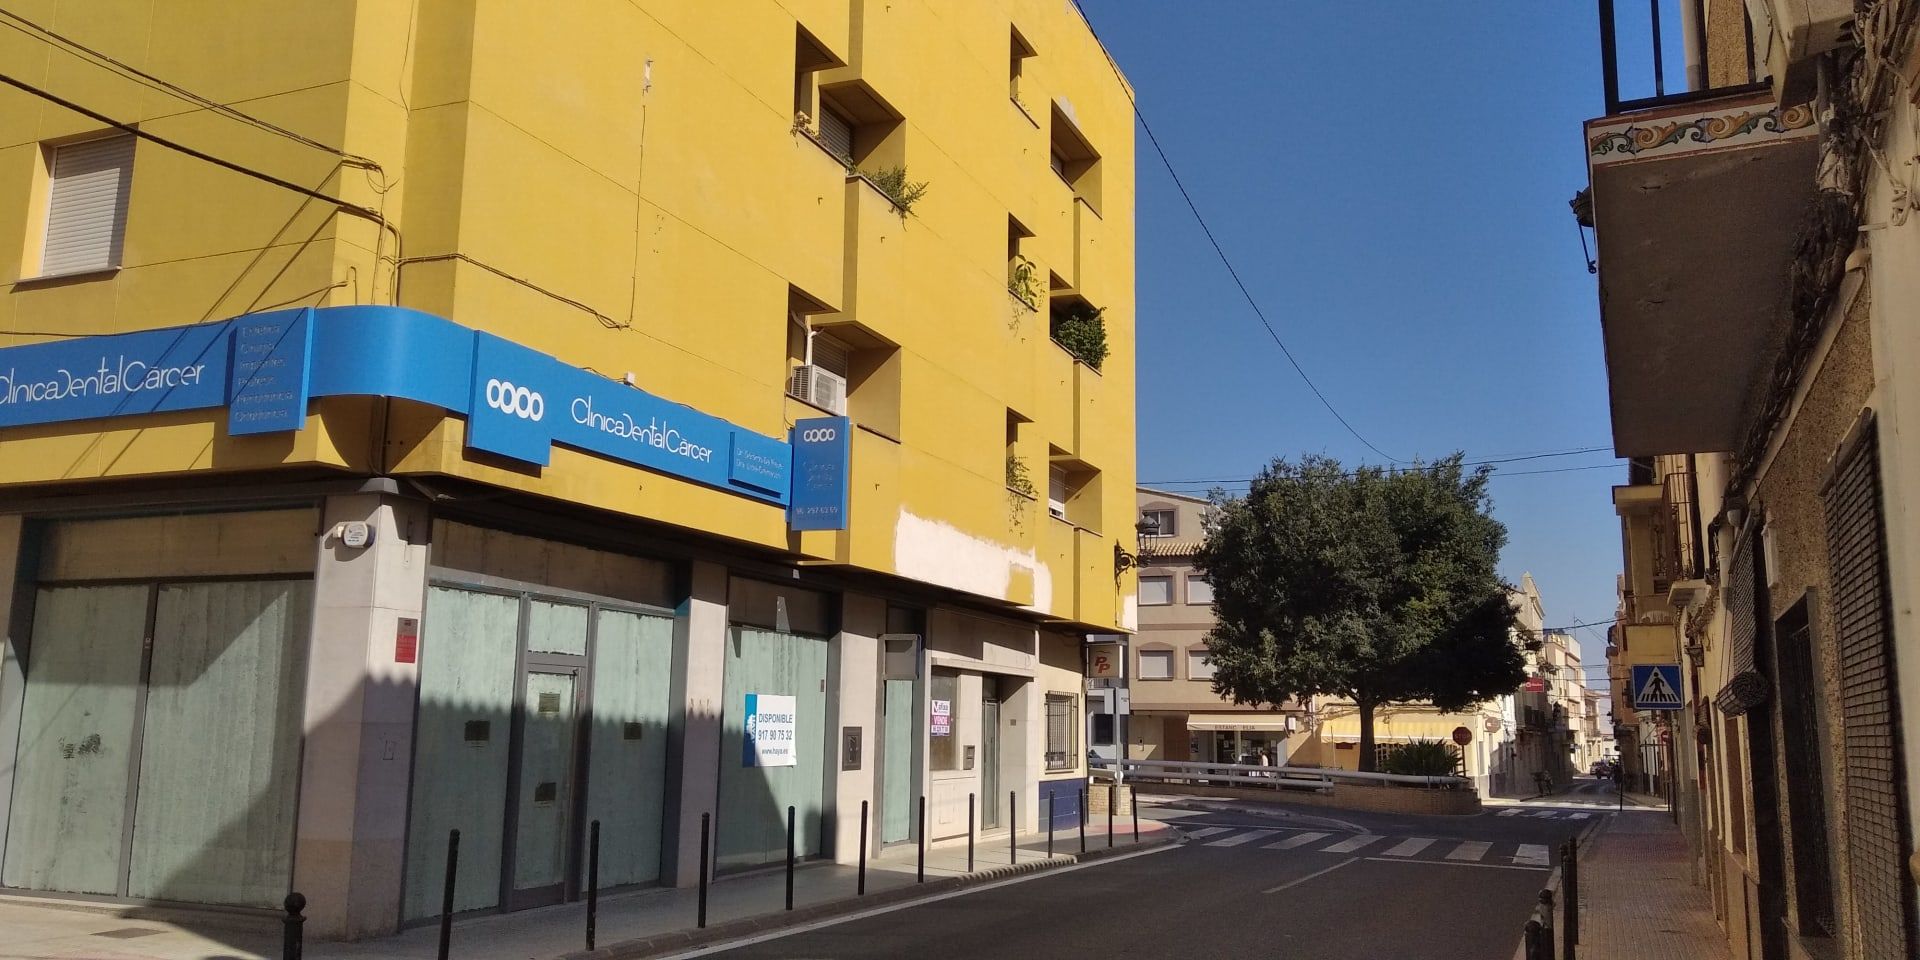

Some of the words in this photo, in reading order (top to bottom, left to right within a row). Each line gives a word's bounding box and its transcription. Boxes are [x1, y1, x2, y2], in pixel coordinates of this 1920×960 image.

[758, 713, 793, 724] DISPONIBLE
[758, 729, 769, 741] 917
[770, 730, 777, 741] 90
[778, 730, 785, 741] 75
[785, 730, 793, 741] 32
